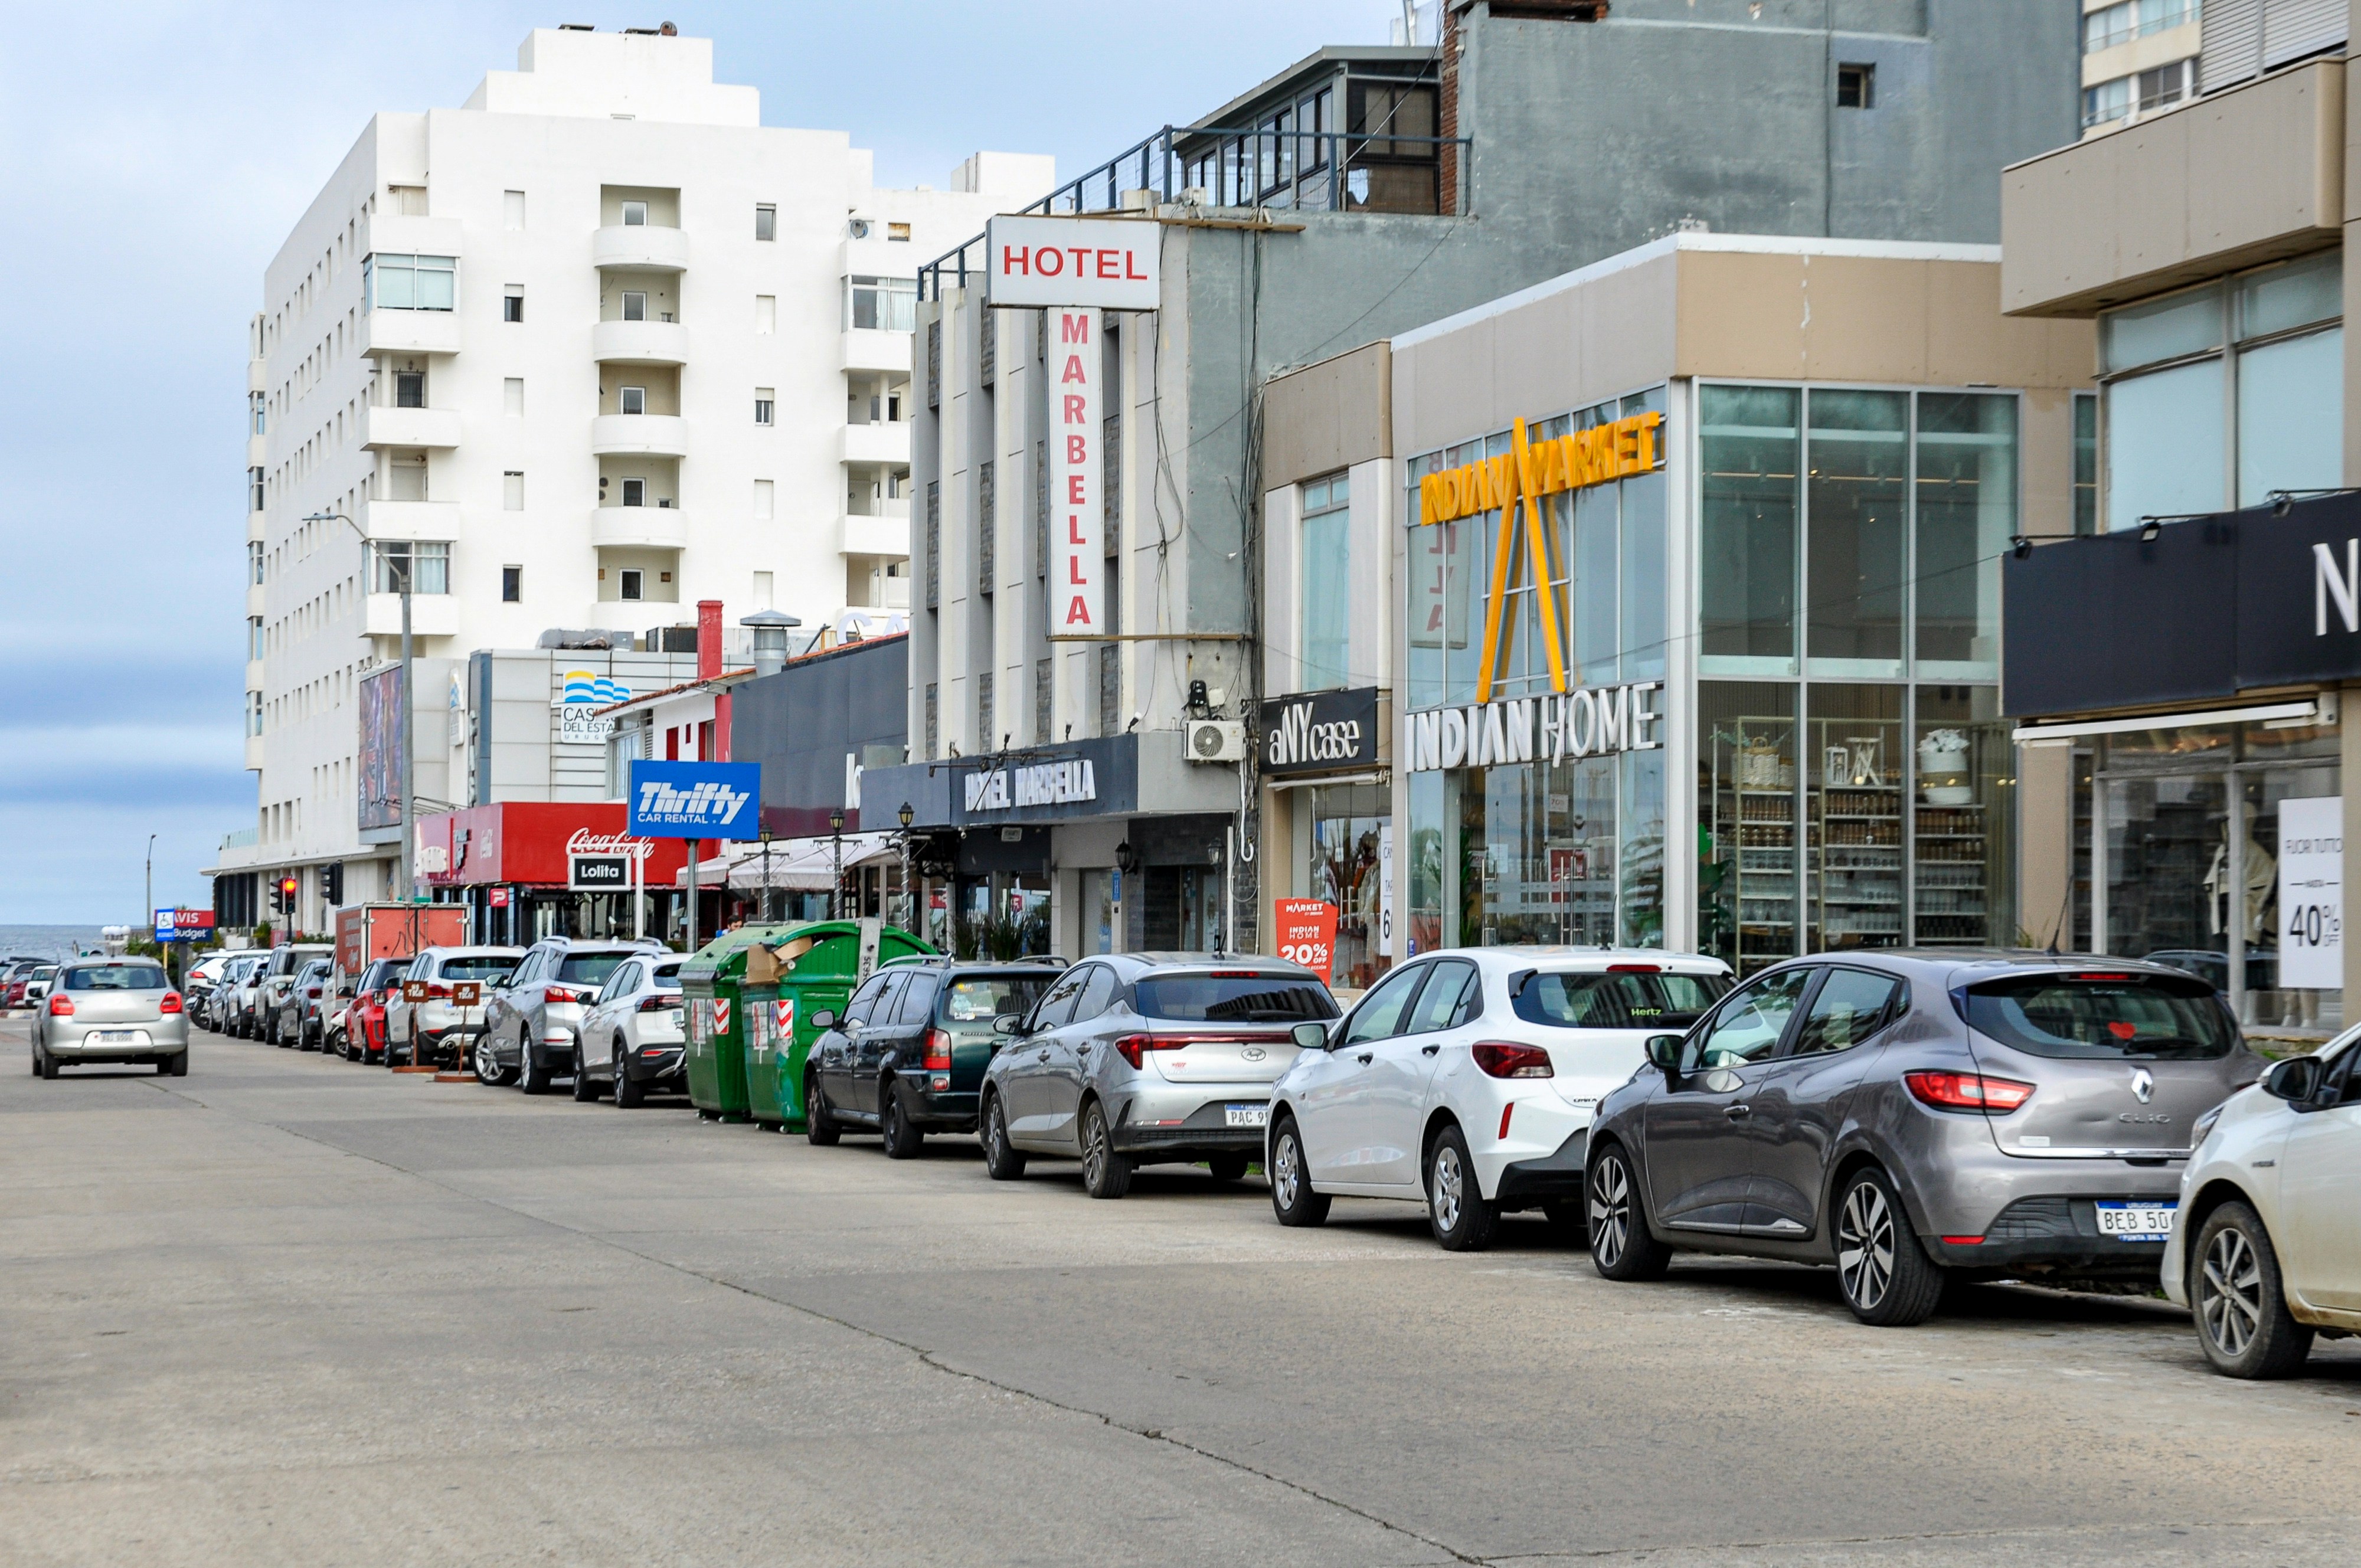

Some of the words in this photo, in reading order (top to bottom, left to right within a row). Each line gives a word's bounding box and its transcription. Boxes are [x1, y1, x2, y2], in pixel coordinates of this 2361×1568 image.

[1004, 245, 1147, 280] HOTEL
[1061, 313, 1090, 624] MARBELLA
[1420, 453, 1512, 526] INDIAN
[1529, 411, 1660, 497] MARKET
[564, 722, 584, 732] DEL
[587, 722, 615, 732] ESTA
[1270, 701, 1360, 765] aNYcase
[1405, 698, 1533, 773] INDIAN
[1541, 682, 1656, 768] HOME
[965, 770, 1011, 812] HOTEL
[1015, 759, 1096, 807] MARBELLA
[638, 781, 750, 825] Thrifty
[637, 813, 662, 823] CAR
[665, 814, 708, 824] RENTAL
[581, 865, 619, 878] Lolita
[1286, 901, 1323, 914] MARKET
[1289, 925, 1320, 934] INDIAN
[1383, 908, 1392, 940] 6
[2290, 904, 2341, 947] 40%
[174, 928, 207, 940] Budget
[1289, 932, 1320, 940] HOME
[1280, 942, 1328, 965] 20%
[1313, 956, 1327, 964] OFF
[1631, 1008, 1662, 1016] Hertz
[1231, 1111, 1253, 1123] PAC
[1258, 1111, 1268, 1123] 9
[2119, 1112, 2170, 1124] CLIO
[2104, 1212, 2138, 1230] BEB
